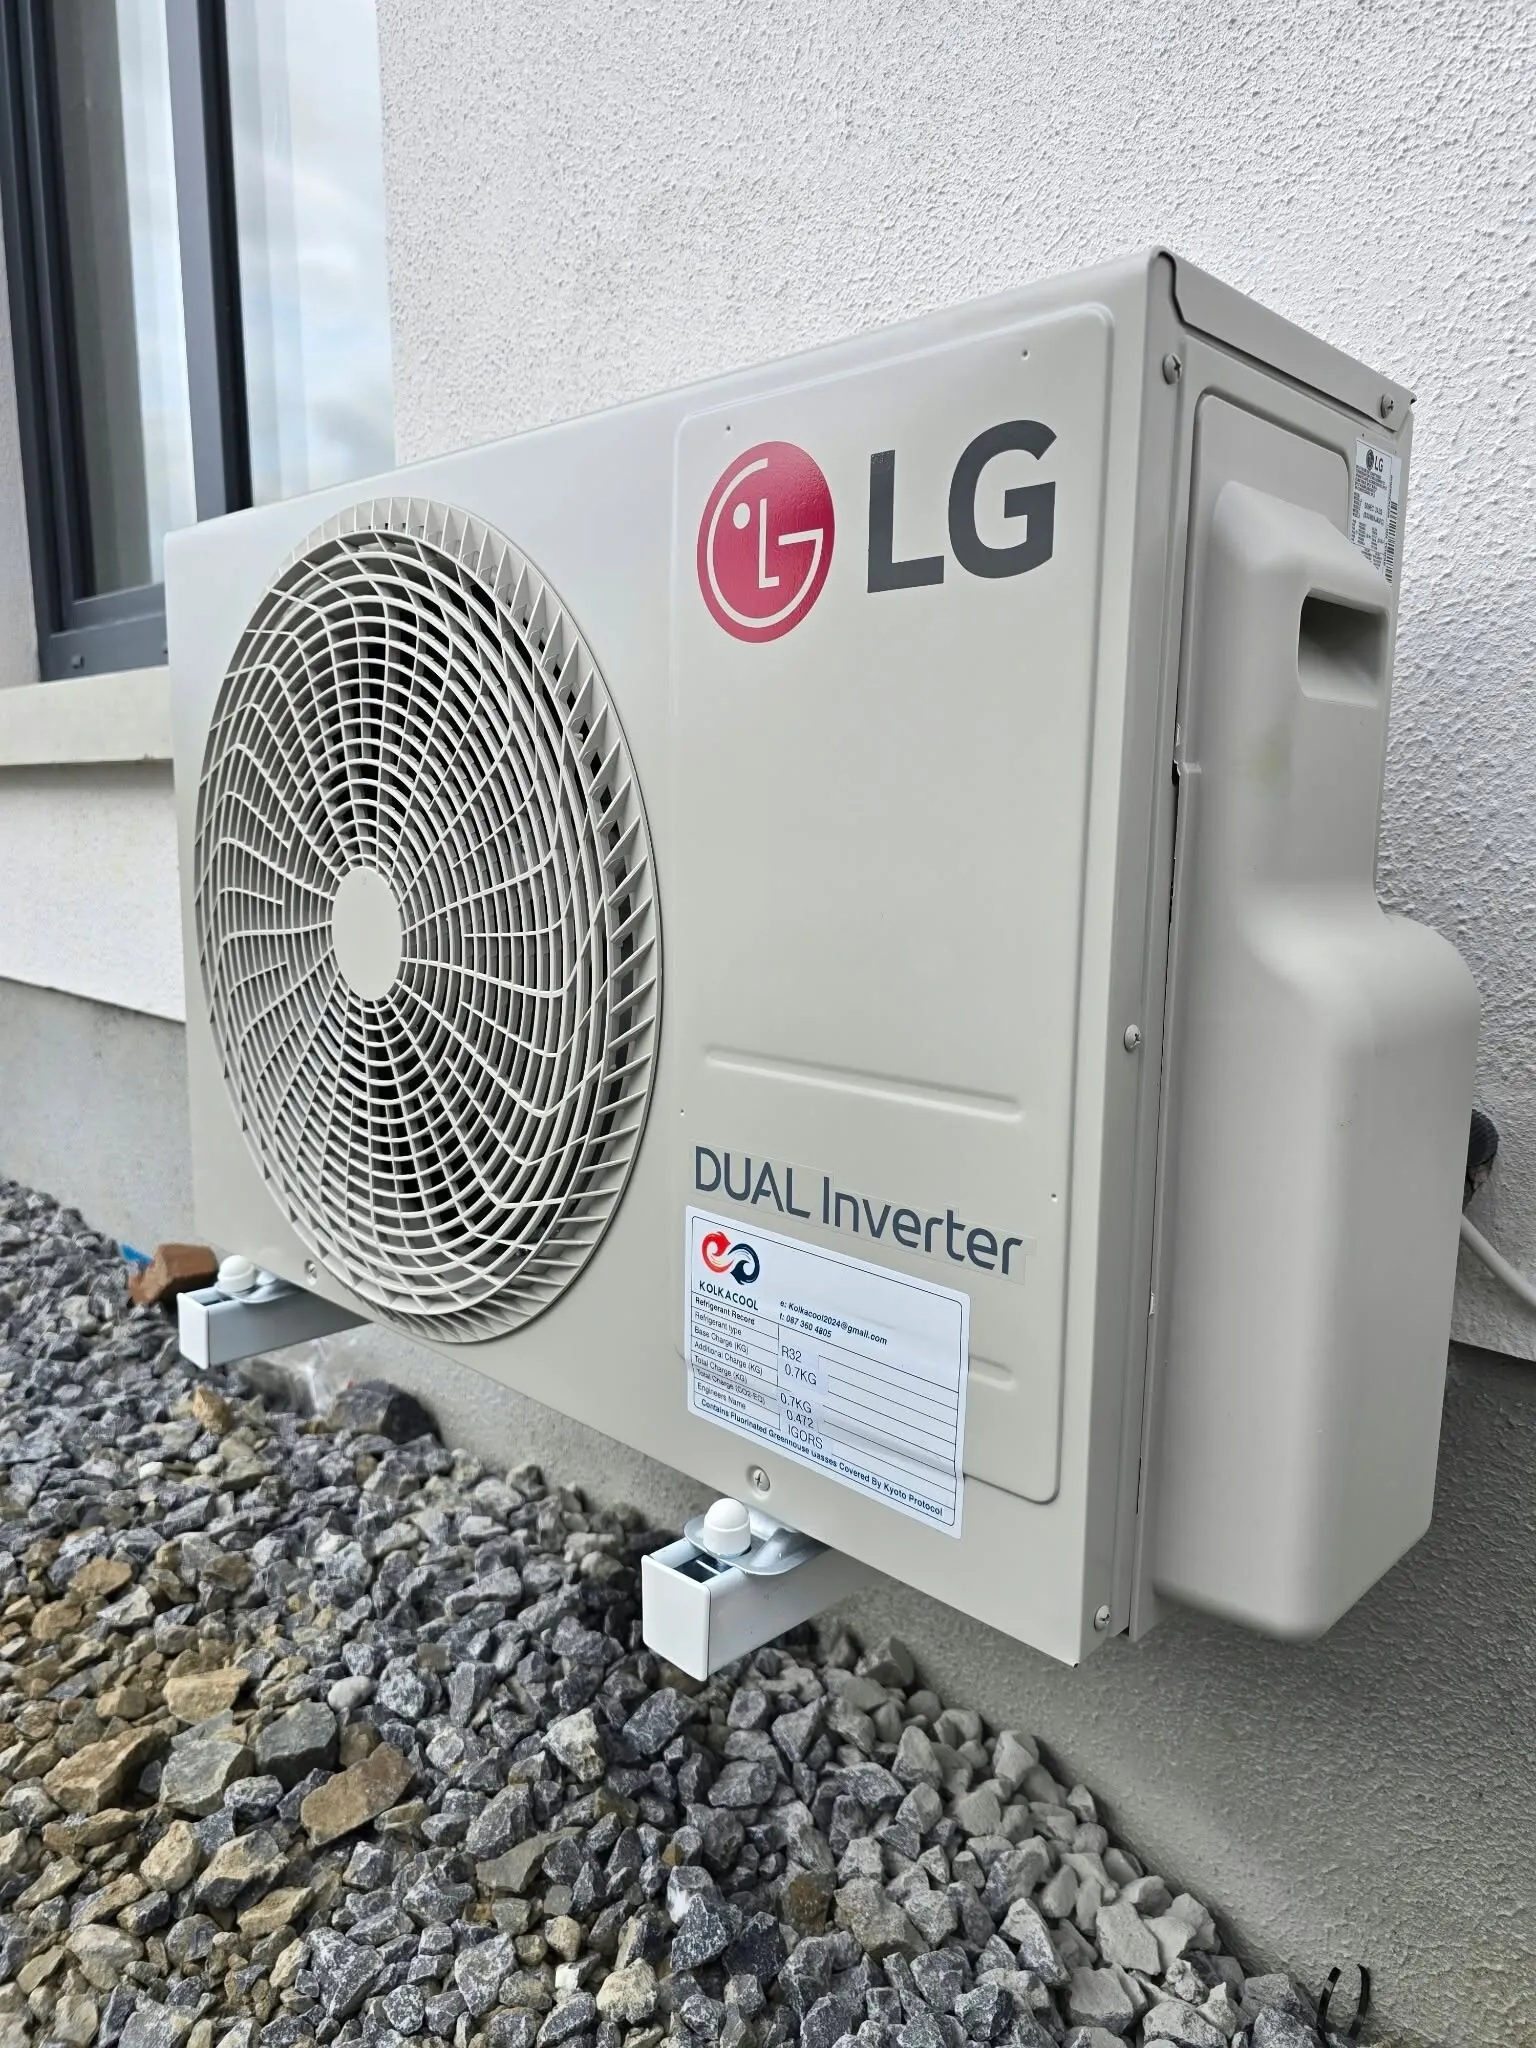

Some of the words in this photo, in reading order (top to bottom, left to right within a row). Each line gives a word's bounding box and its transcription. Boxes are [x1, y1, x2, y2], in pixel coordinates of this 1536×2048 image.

[1375, 455, 1384, 473] LG
[867, 420, 1057, 593] LG
[695, 1145, 811, 1220] DUAL
[822, 1176, 1024, 1276] Inverter
[699, 1279, 759, 1311] KOLKACOOL
[694, 1311, 728, 1329] Refrigerant
[728, 1324, 742, 1336] type
[695, 1296, 731, 1316] Refrigerant
[731, 1310, 755, 1326] Record
[788, 1302, 888, 1346] Kolkacool2024@gmail.com
[786, 1314, 800, 1326] 087
[800, 1319, 813, 1331] 360
[814, 1325, 832, 1338] 4805
[694, 1325, 709, 1338] Base
[711, 1332, 733, 1348] Charge
[734, 1343, 749, 1356] (KG)
[781, 1345, 802, 1363] R32
[694, 1340, 723, 1358] Additional
[724, 1352, 747, 1369] Charge
[748, 1362, 763, 1376] (KG)
[694, 1355, 709, 1367] Total
[709, 1360, 732, 1377] Charge
[732, 1372, 748, 1385] (KG)
[696, 1369, 711, 1380] Total
[711, 1374, 734, 1390] Charge
[784, 1363, 817, 1386] 0.7KG
[697, 1382, 727, 1401] Engineers
[728, 1395, 746, 1410] Name
[780, 1392, 812, 1414] 0.7KG
[786, 1409, 815, 1429] 0.472
[788, 1424, 823, 1450] IGORS
[701, 1398, 729, 1417] Contains
[730, 1411, 767, 1434] Fluorinated
[839, 1462, 870, 1482] Covered
[871, 1476, 882, 1490] By
[883, 1482, 907, 1500] Kyoto
[908, 1493, 944, 1517] Protocol
